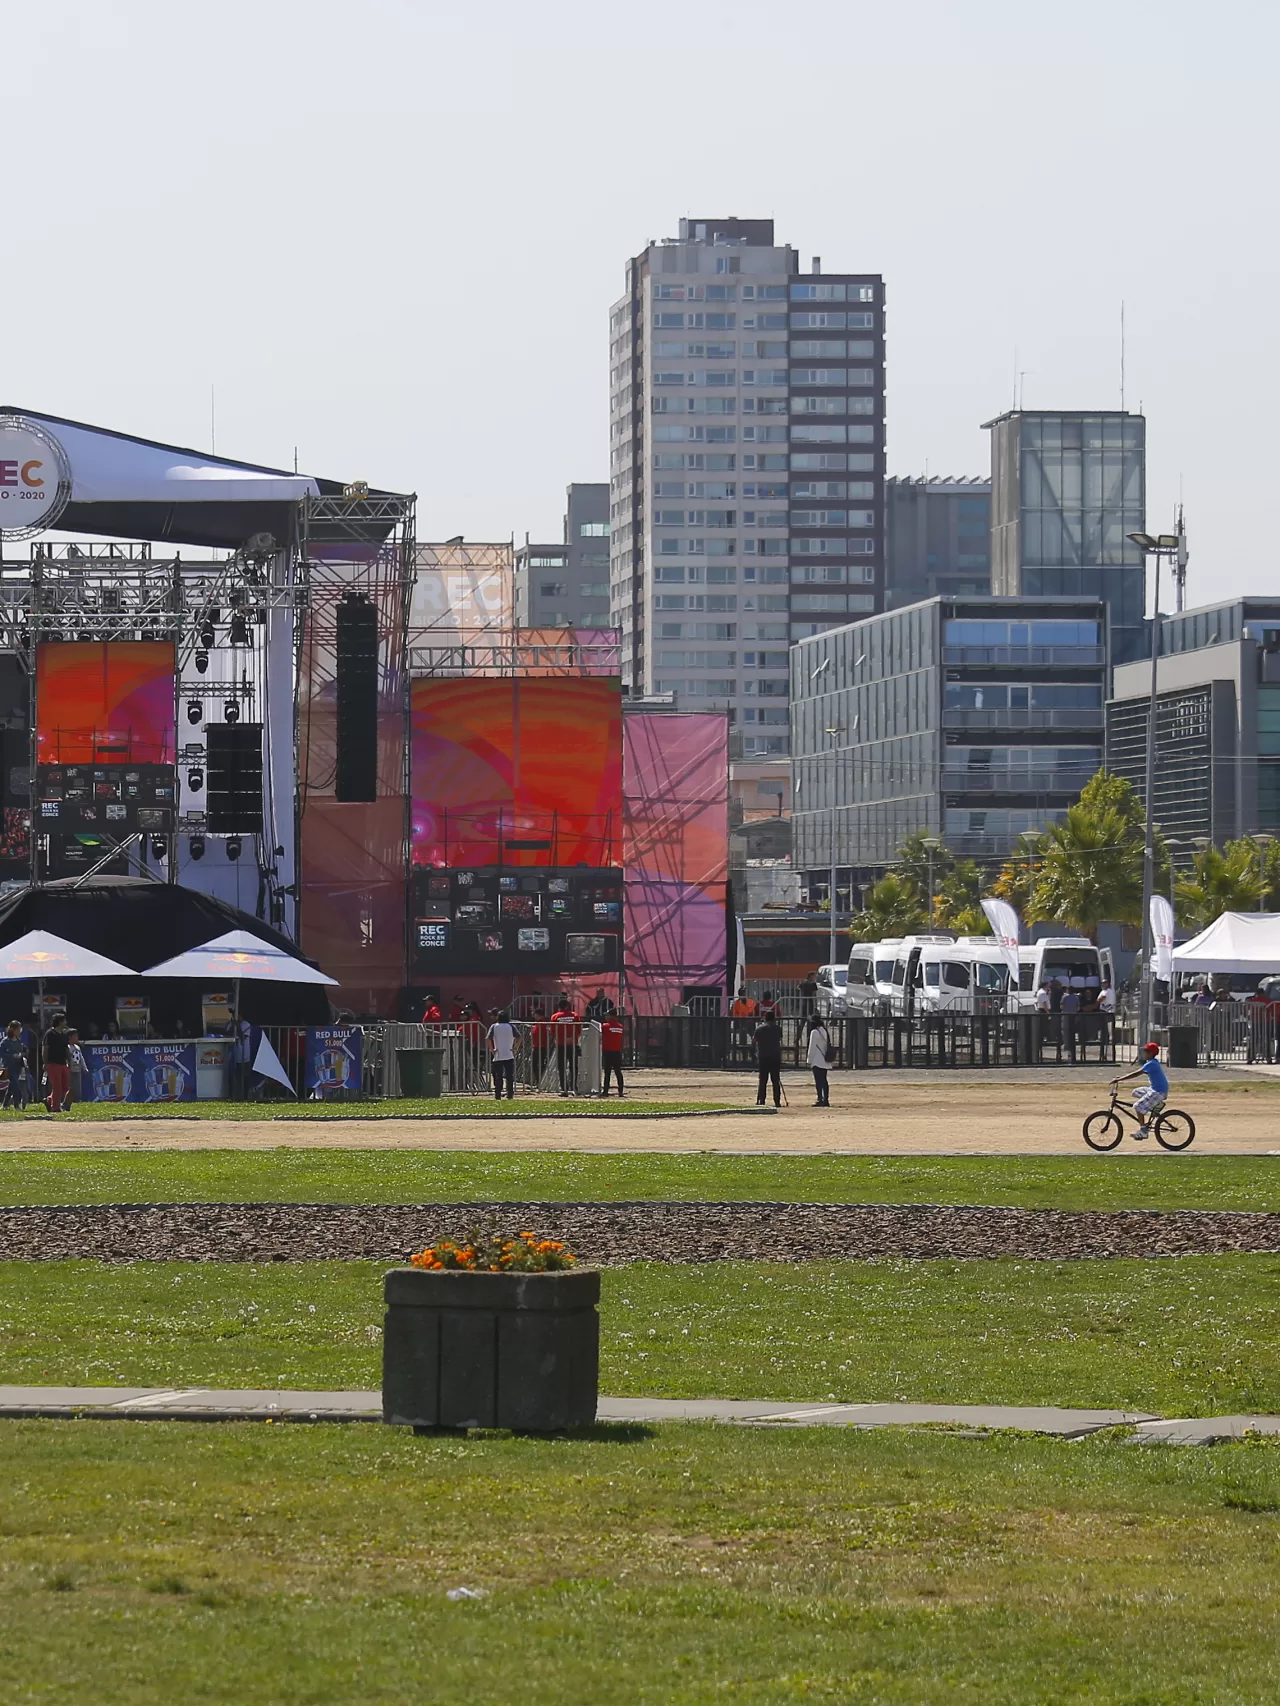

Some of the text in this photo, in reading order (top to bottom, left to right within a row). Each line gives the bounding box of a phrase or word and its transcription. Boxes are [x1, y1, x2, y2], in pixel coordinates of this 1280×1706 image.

[19, 491, 45, 500] 2020
[414, 576, 504, 610] REC
[420, 925, 445, 935] REC
[315, 1031, 331, 1039] RED
[332, 1030, 352, 1038] BULL
[92, 1045, 132, 1055] RED BULL
[163, 1045, 184, 1053] BULL
